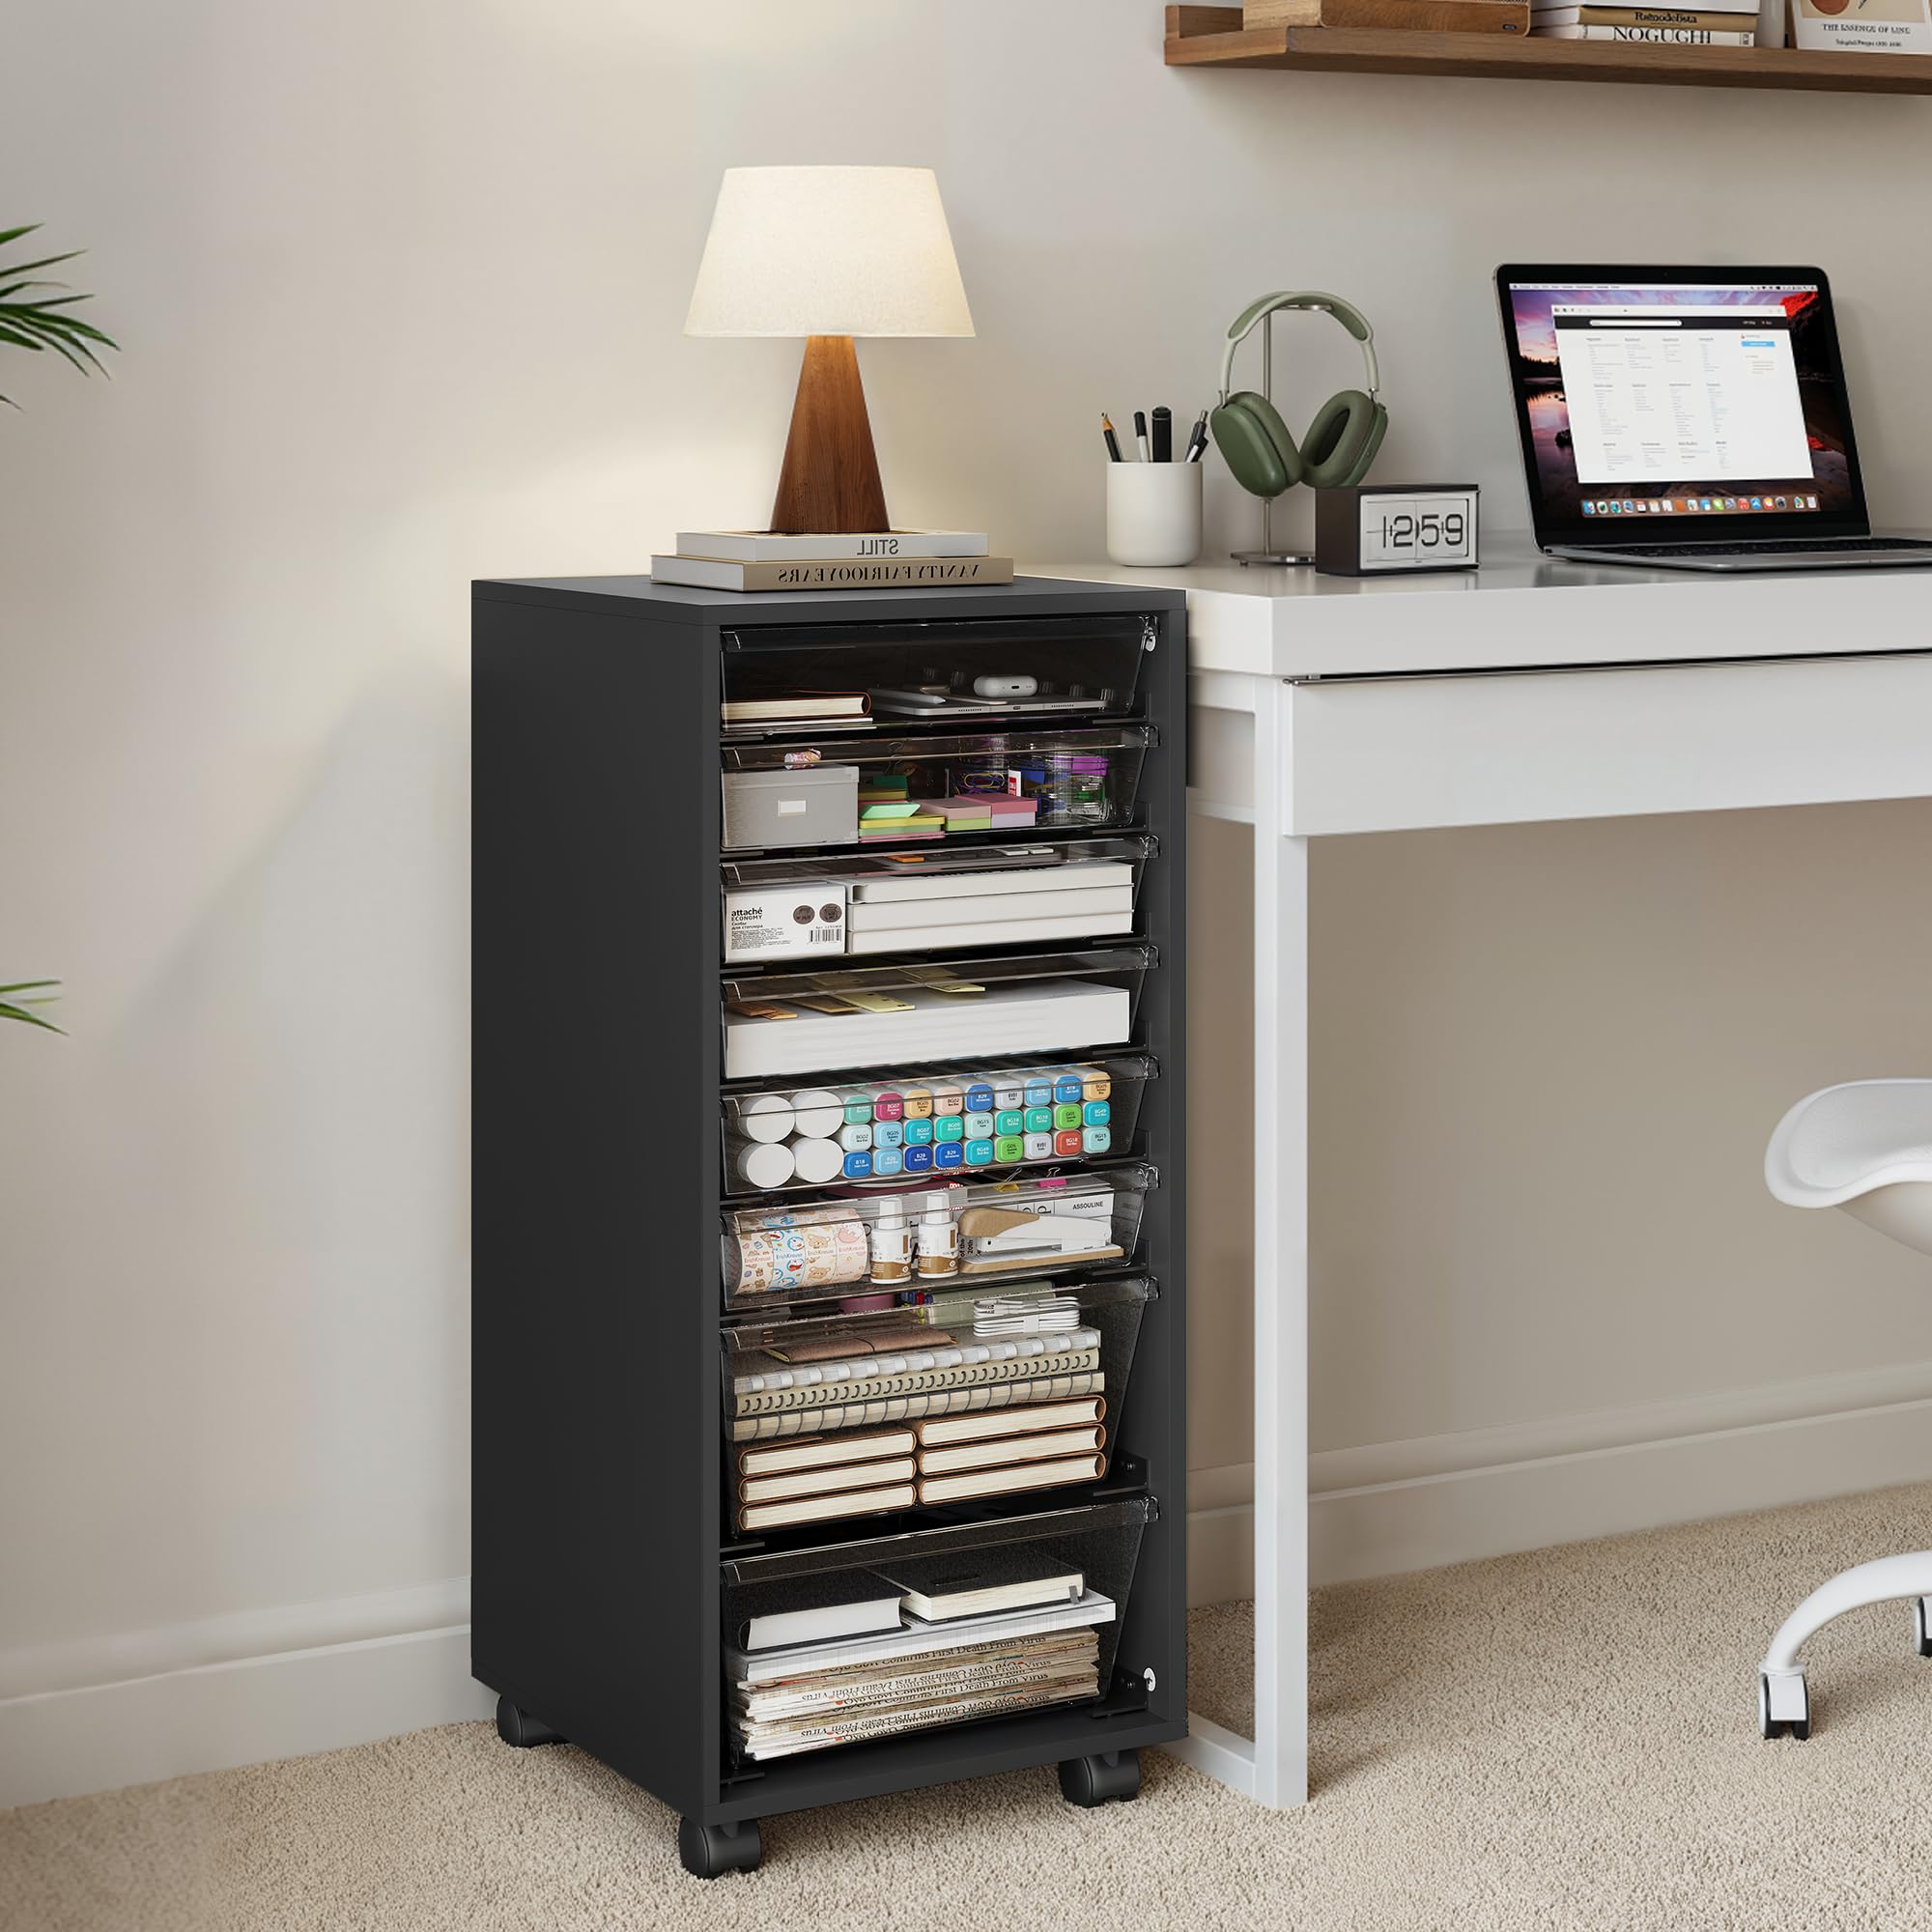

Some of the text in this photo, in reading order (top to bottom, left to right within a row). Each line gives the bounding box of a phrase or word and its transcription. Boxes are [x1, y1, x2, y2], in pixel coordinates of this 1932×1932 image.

[731, 907, 763, 917] attaché
[1072, 1201, 1103, 1210] ASSOULINE
[932, 1648, 954, 1658] First
[957, 1641, 986, 1653] Death
[990, 1639, 1017, 1650] From
[1025, 1660, 1051, 1669] Virus
[934, 1686, 957, 1696] First
[959, 1681, 989, 1692] Death
[992, 1676, 1019, 1687] From
[1022, 1673, 1049, 1682] Virus
